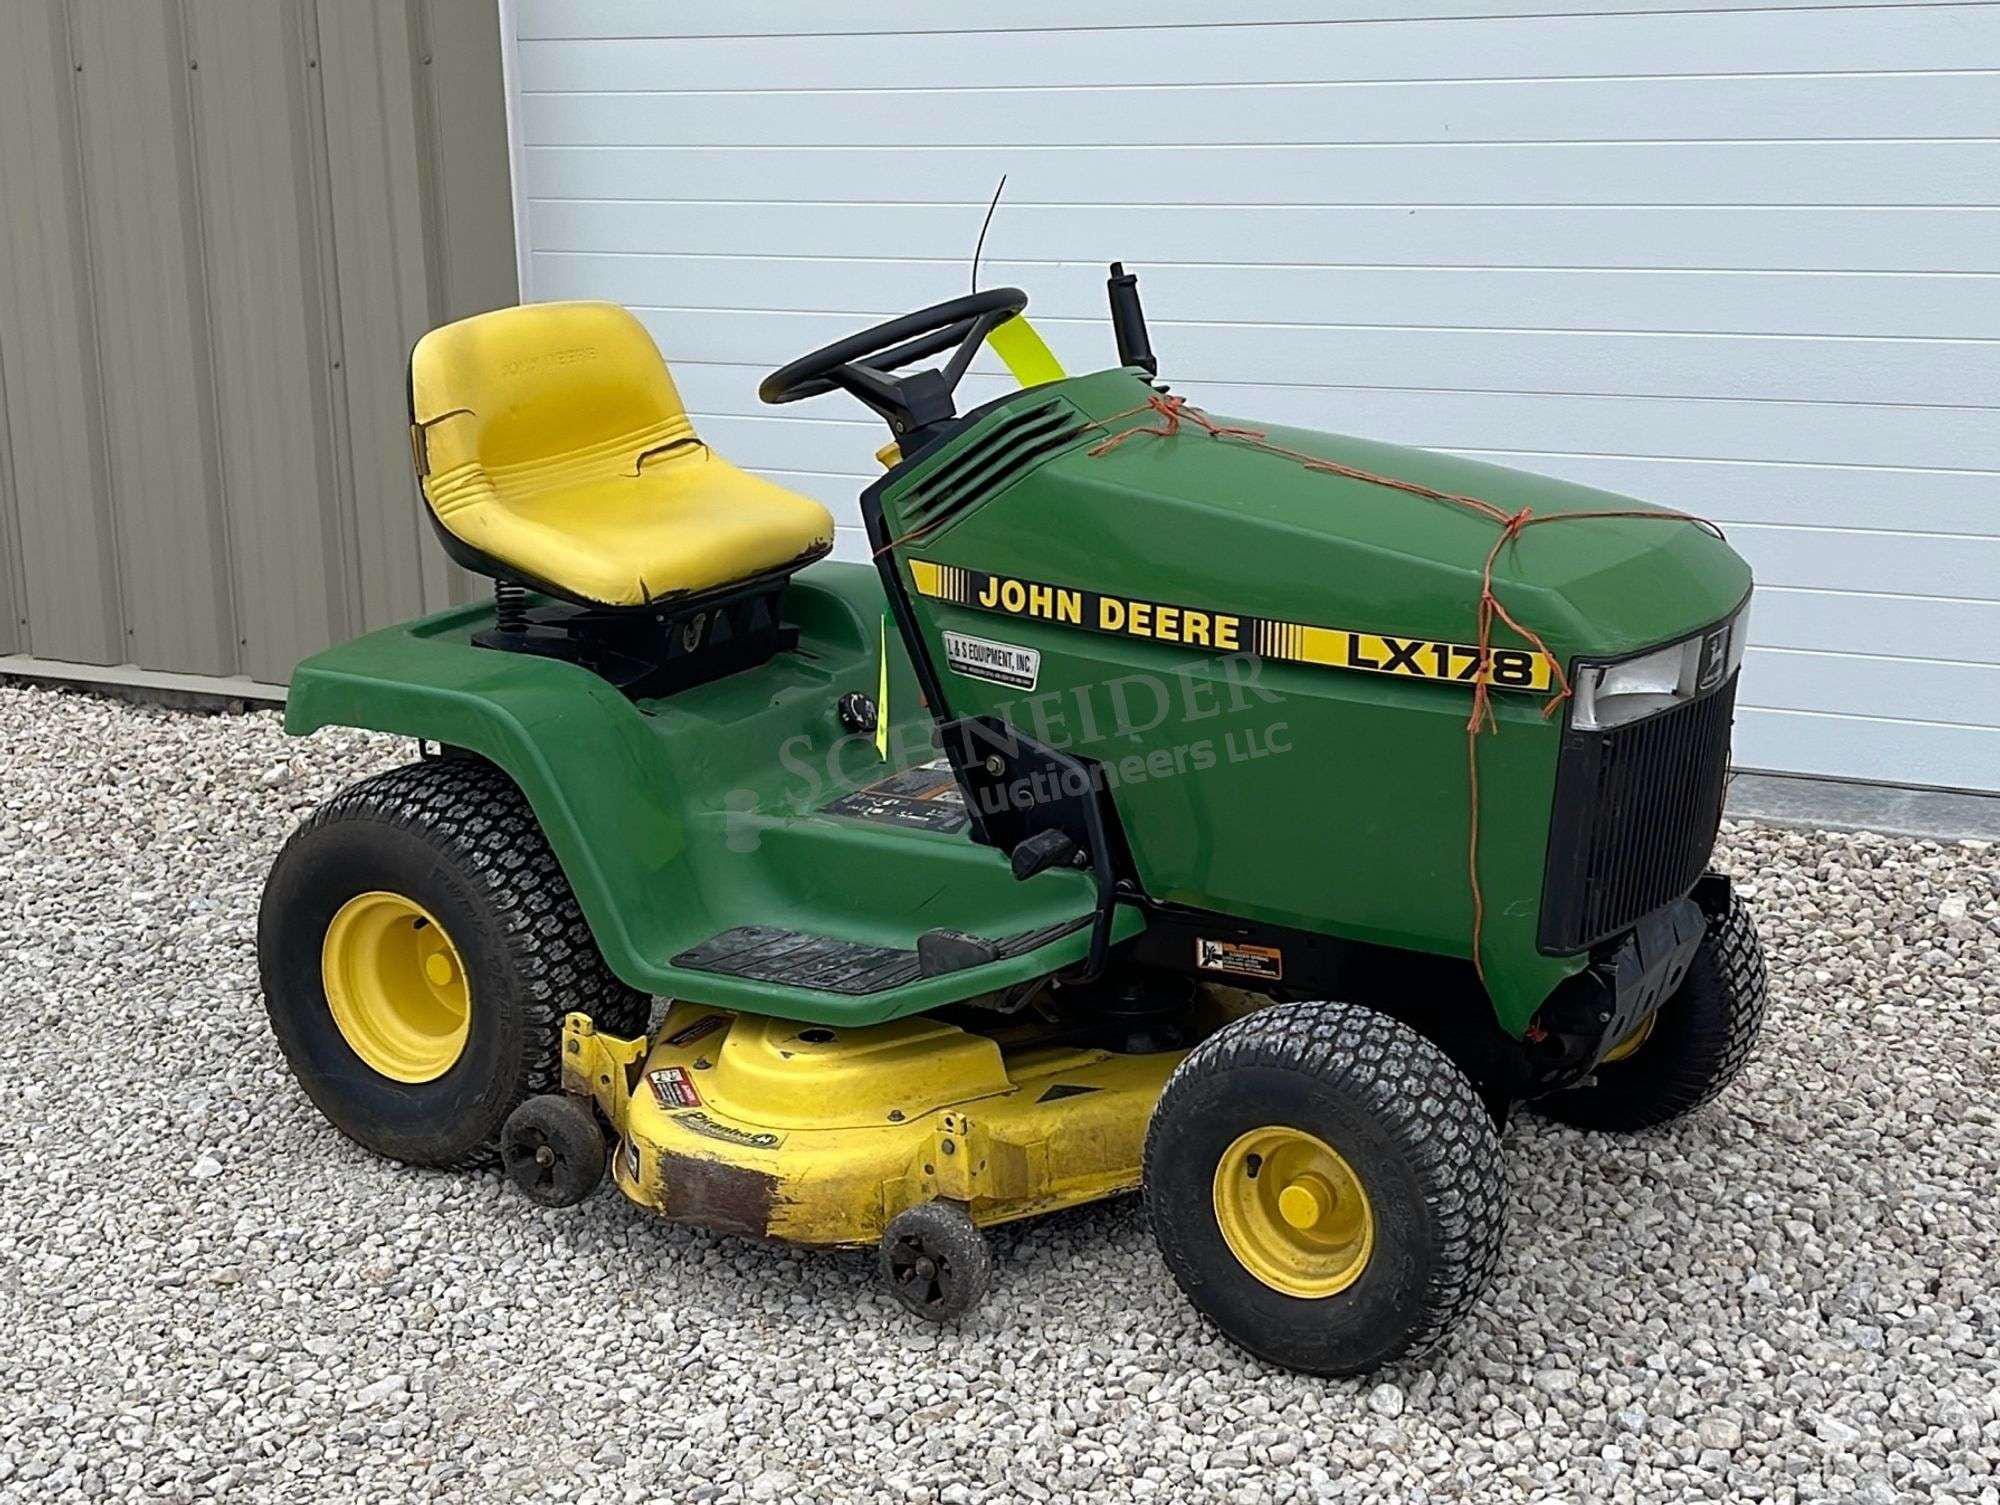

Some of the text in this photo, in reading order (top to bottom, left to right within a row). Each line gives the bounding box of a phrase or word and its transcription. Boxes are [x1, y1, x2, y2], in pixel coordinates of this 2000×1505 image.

[979, 576, 1239, 650] JOHN DEERE
[962, 642, 967, 658] S
[1348, 633, 1532, 686] LX178
[687, 1111, 753, 1139] Piranha
